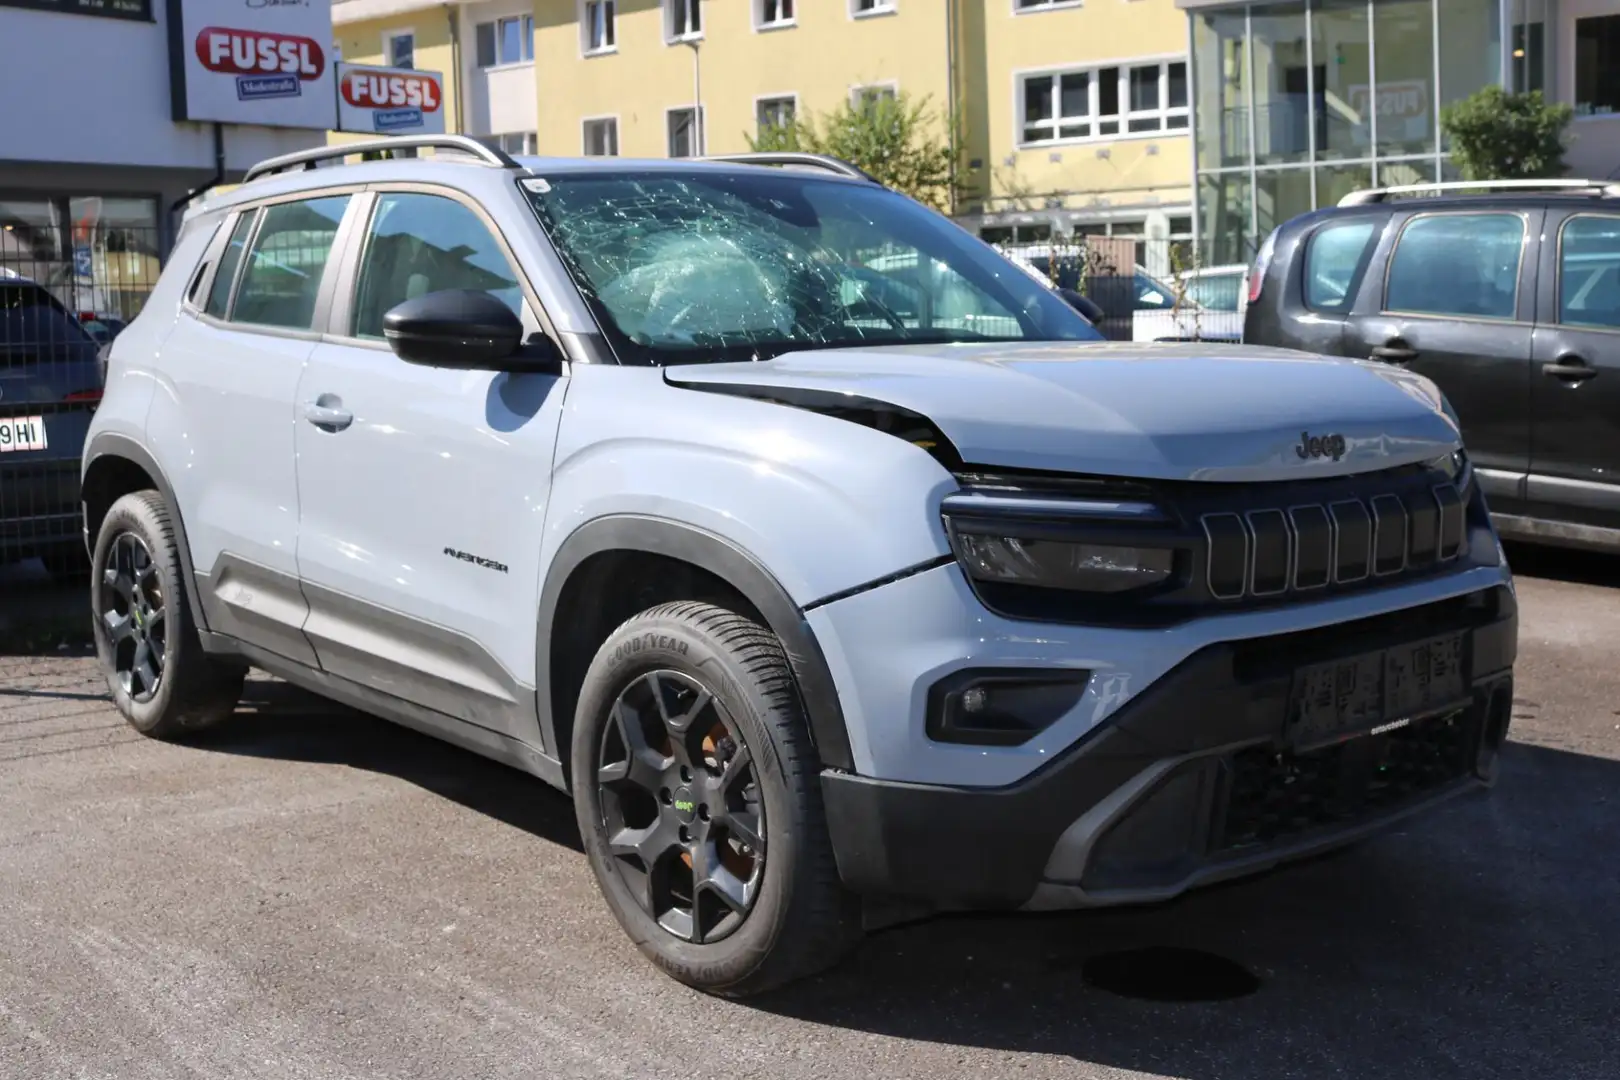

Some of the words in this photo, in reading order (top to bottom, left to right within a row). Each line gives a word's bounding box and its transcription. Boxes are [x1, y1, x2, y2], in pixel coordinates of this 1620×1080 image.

[209, 33, 317, 74] FUSSL
[351, 74, 436, 107] FUSSL
[1295, 431, 1346, 462] Jeep
